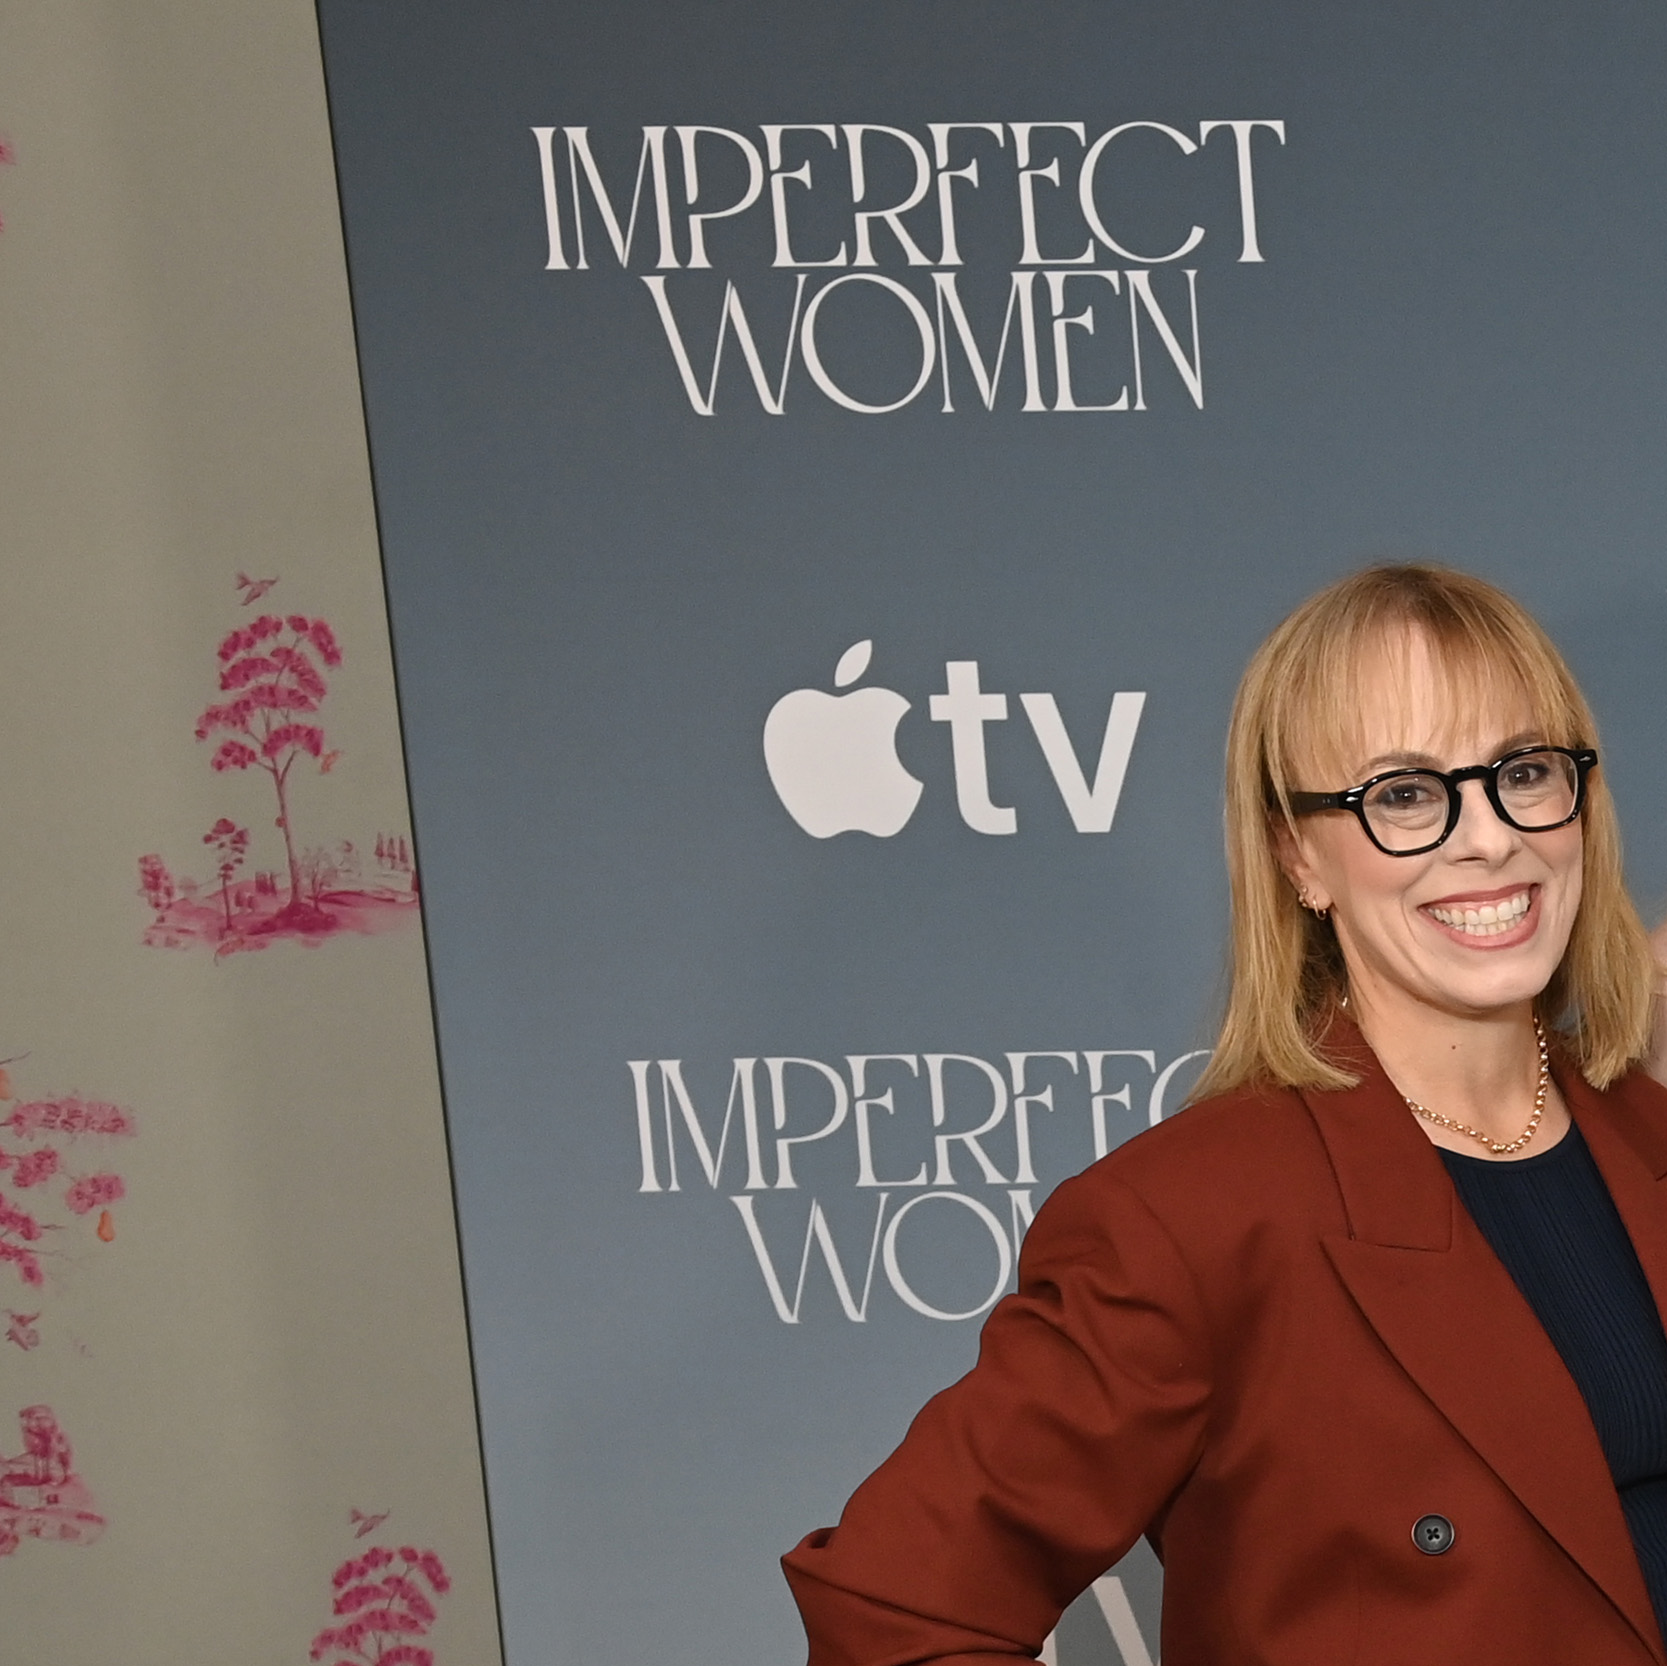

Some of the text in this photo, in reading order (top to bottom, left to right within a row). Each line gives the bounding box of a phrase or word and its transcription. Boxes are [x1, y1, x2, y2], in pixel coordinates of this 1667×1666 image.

[530, 119, 1286, 271] IMPERFECT
[642, 268, 1206, 416] WOMEN
[929, 660, 1148, 835] tv
[627, 1050, 1214, 1193] IMPERFE
